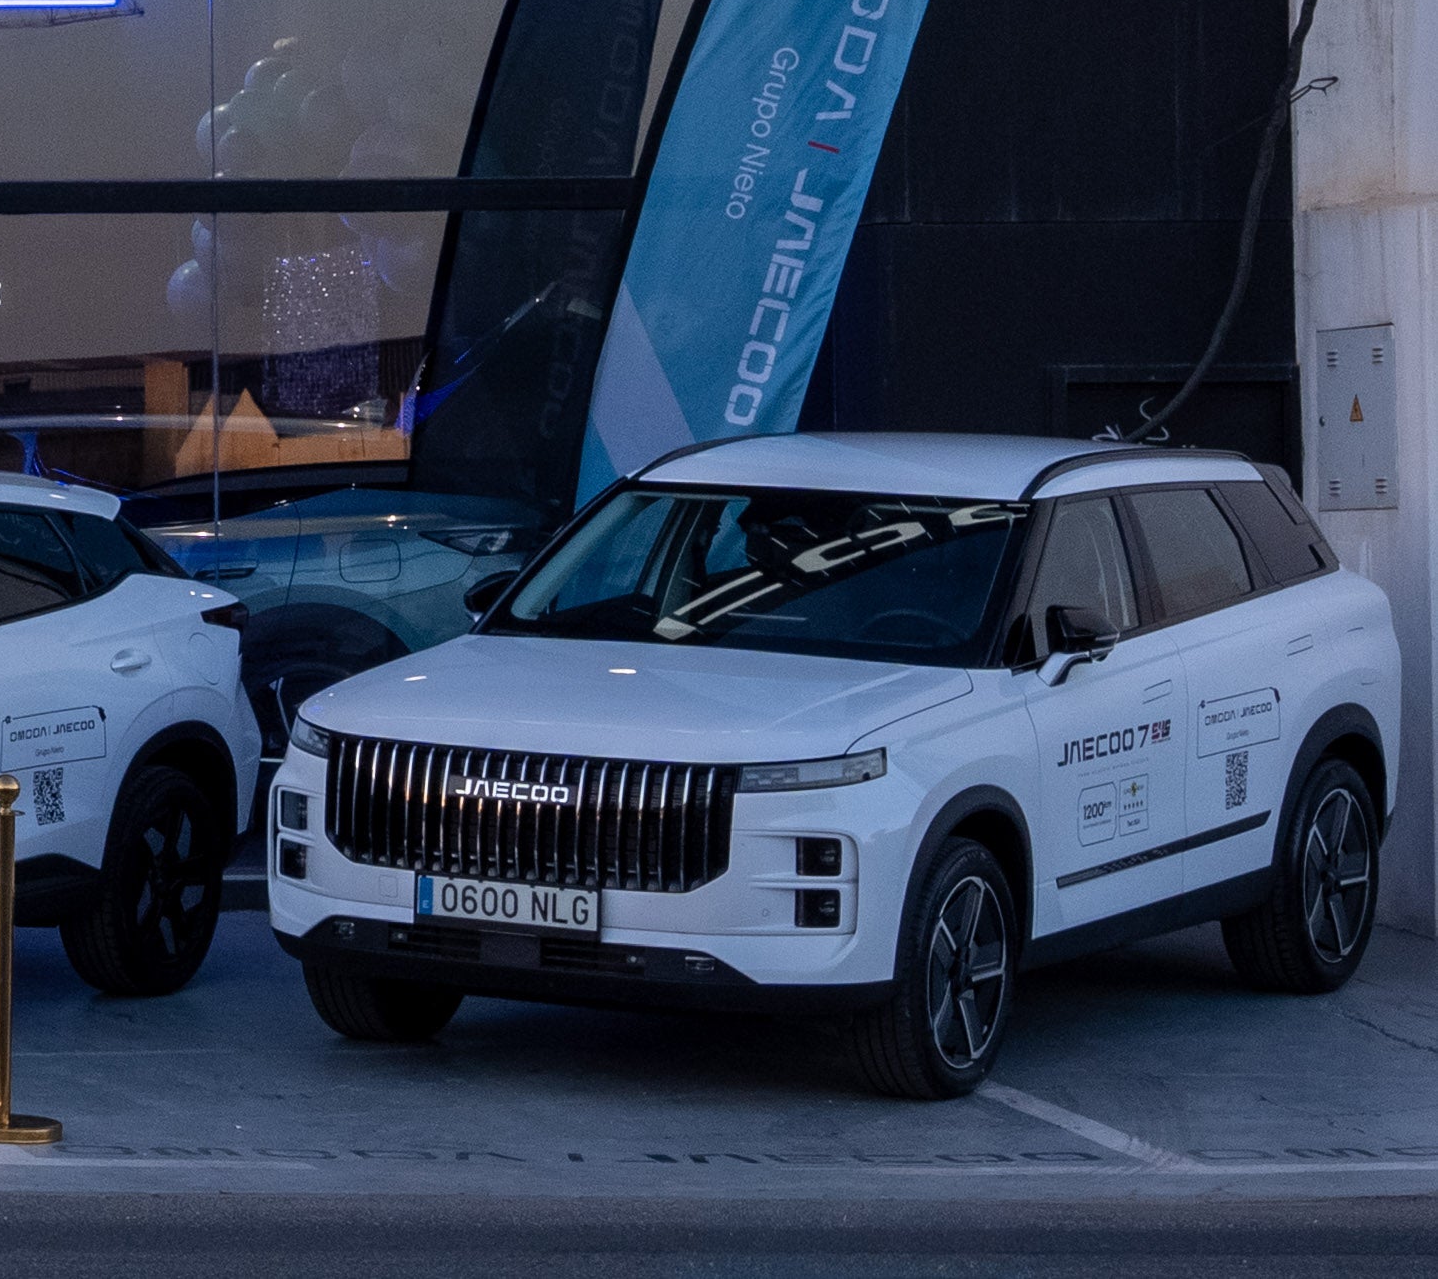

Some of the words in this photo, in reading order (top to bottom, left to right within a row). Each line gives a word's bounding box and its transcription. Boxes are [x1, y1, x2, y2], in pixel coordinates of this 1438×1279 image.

[750, 45, 800, 141] Grupo
[725, 144, 772, 221] Nieto
[724, 168, 832, 426] JAECOO
[52, 719, 96, 736] JAECOO
[1057, 727, 1134, 768] JAECOO
[1137, 724, 1151, 749] 7
[455, 779, 569, 803] JAECOO
[441, 882, 519, 920] 0600
[531, 889, 590, 926] NLG
